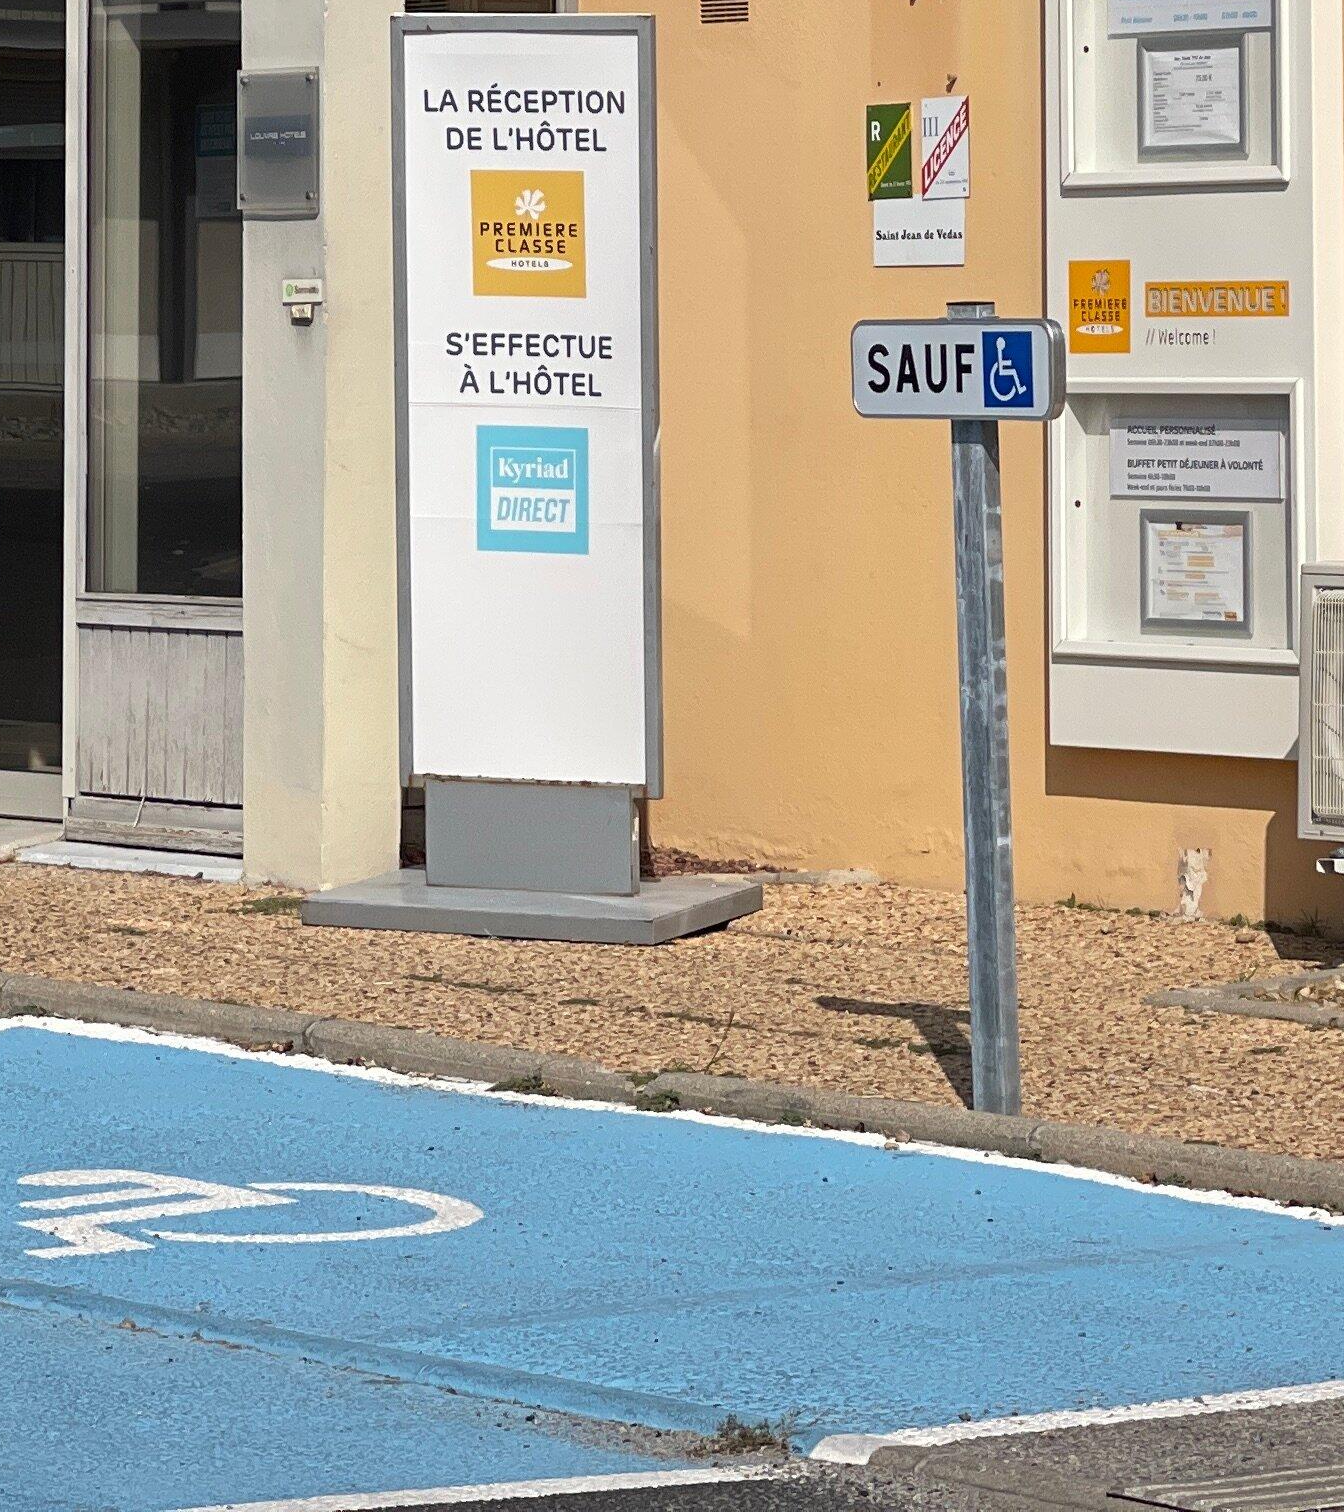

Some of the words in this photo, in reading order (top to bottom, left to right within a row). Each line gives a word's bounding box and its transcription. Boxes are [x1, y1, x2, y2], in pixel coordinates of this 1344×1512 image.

[424, 88, 459, 113] LA
[470, 84, 626, 115] RÉCEPTION
[445, 127, 483, 151] DE
[493, 121, 607, 152] L'HÔTEL
[871, 120, 881, 142] R
[924, 104, 968, 190] LICENCE
[479, 221, 579, 239] PREMIERE
[875, 229, 899, 241] Saint
[900, 228, 922, 240] Jean
[923, 228, 935, 240] de
[494, 238, 568, 256] CLASSE
[511, 259, 550, 269] HOTELS
[1073, 298, 1127, 310] PREMIERE
[1147, 287, 1277, 313] BIENVENUE
[1080, 310, 1121, 323] CLASSE
[445, 332, 613, 360] S'EFFECTUE
[1158, 326, 1210, 346] Welcome
[460, 364, 479, 394] À
[490, 365, 602, 397] L'HÔTEL
[867, 343, 975, 394] SAUF
[497, 456, 570, 483] Kyriad
[1127, 459, 1155, 469] BUFFET
[1157, 459, 1179, 469] PETIT
[1179, 458, 1219, 470] DÉJEUNER
[1227, 459, 1264, 471] VOLONTÉ
[497, 496, 571, 524] DIRECT
